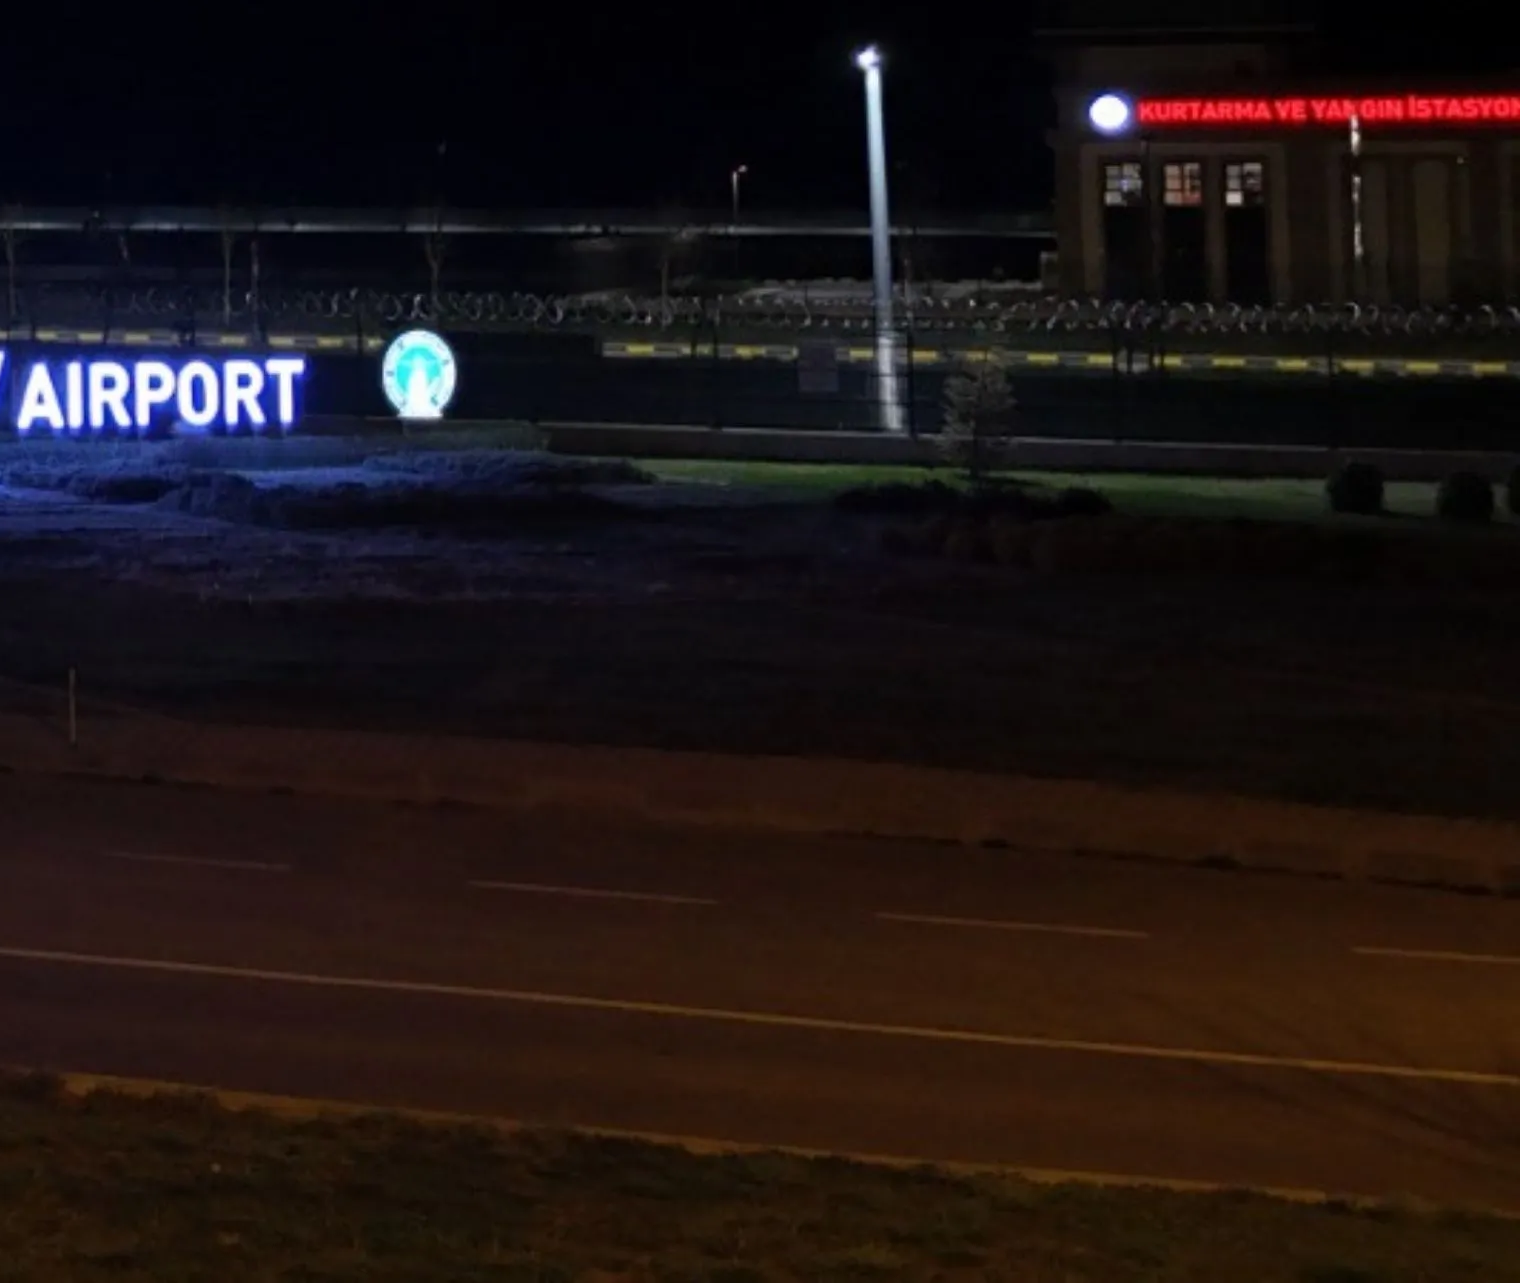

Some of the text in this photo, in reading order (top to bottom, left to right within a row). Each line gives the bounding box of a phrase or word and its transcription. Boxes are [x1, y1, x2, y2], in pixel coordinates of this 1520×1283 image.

[1138, 101, 1272, 122] KURTARMA
[1274, 99, 1307, 121] VE
[16, 358, 306, 431] AIRPORT
